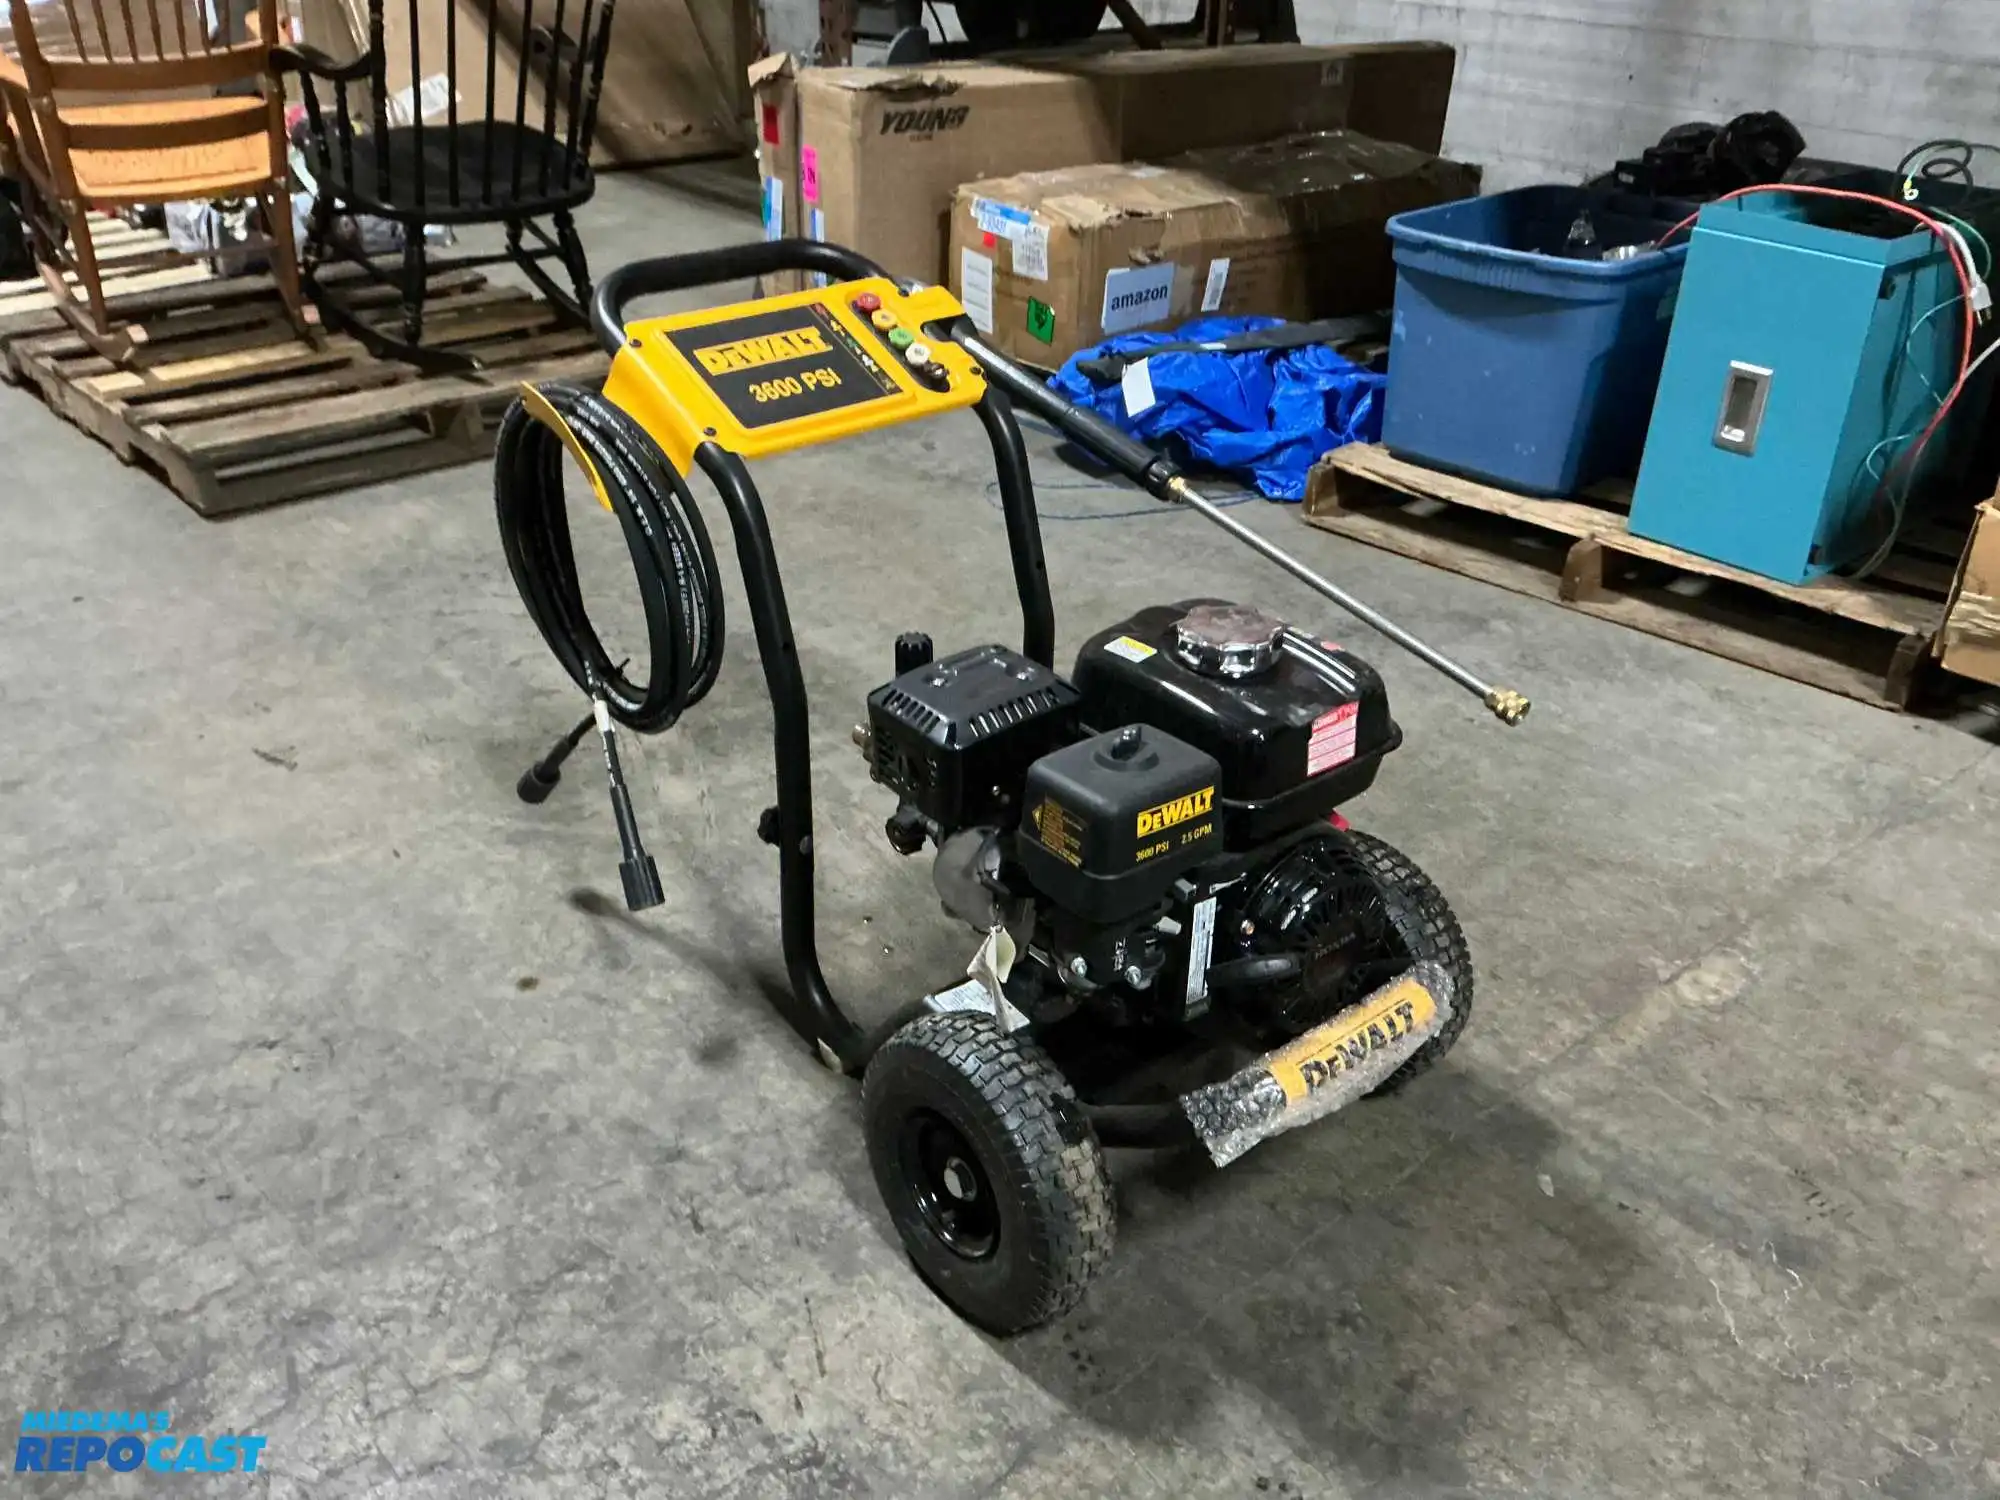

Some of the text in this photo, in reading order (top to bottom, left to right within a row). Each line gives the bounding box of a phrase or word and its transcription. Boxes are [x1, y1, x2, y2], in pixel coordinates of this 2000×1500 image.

[1111, 284, 1168, 311] amazon
[749, 367, 842, 402] 3600 PSI
[1136, 847, 1153, 863] 3600
[1155, 840, 1169, 856] PSI
[1193, 823, 1212, 840] GPM
